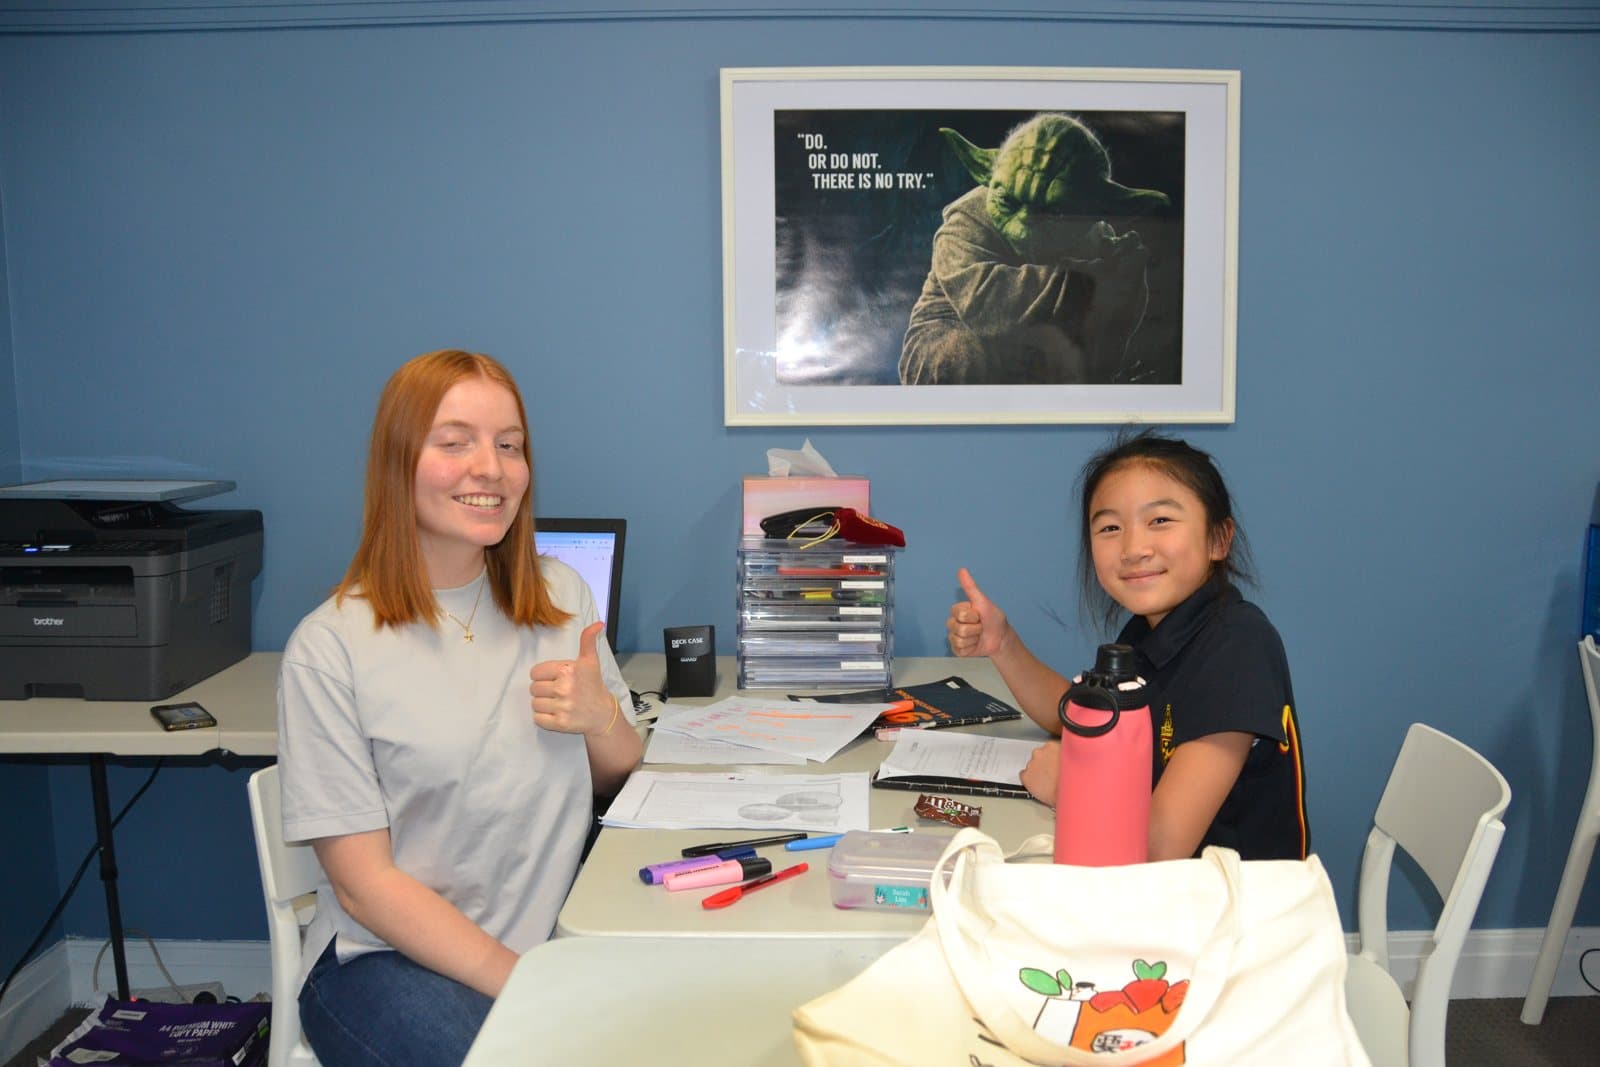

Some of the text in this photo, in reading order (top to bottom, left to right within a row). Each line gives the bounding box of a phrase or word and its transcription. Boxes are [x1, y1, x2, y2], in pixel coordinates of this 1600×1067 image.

[797, 133, 828, 149] "DO.
[808, 153, 882, 169] OR DO NOT.
[812, 173, 934, 189] THERE IS NO TRY."
[33, 617, 64, 626] brother
[688, 637, 703, 645] CASE
[172, 1020, 210, 1031] PREMIUM
[211, 1020, 237, 1030] WHITE
[169, 1028, 220, 1038] COPY PAPER
